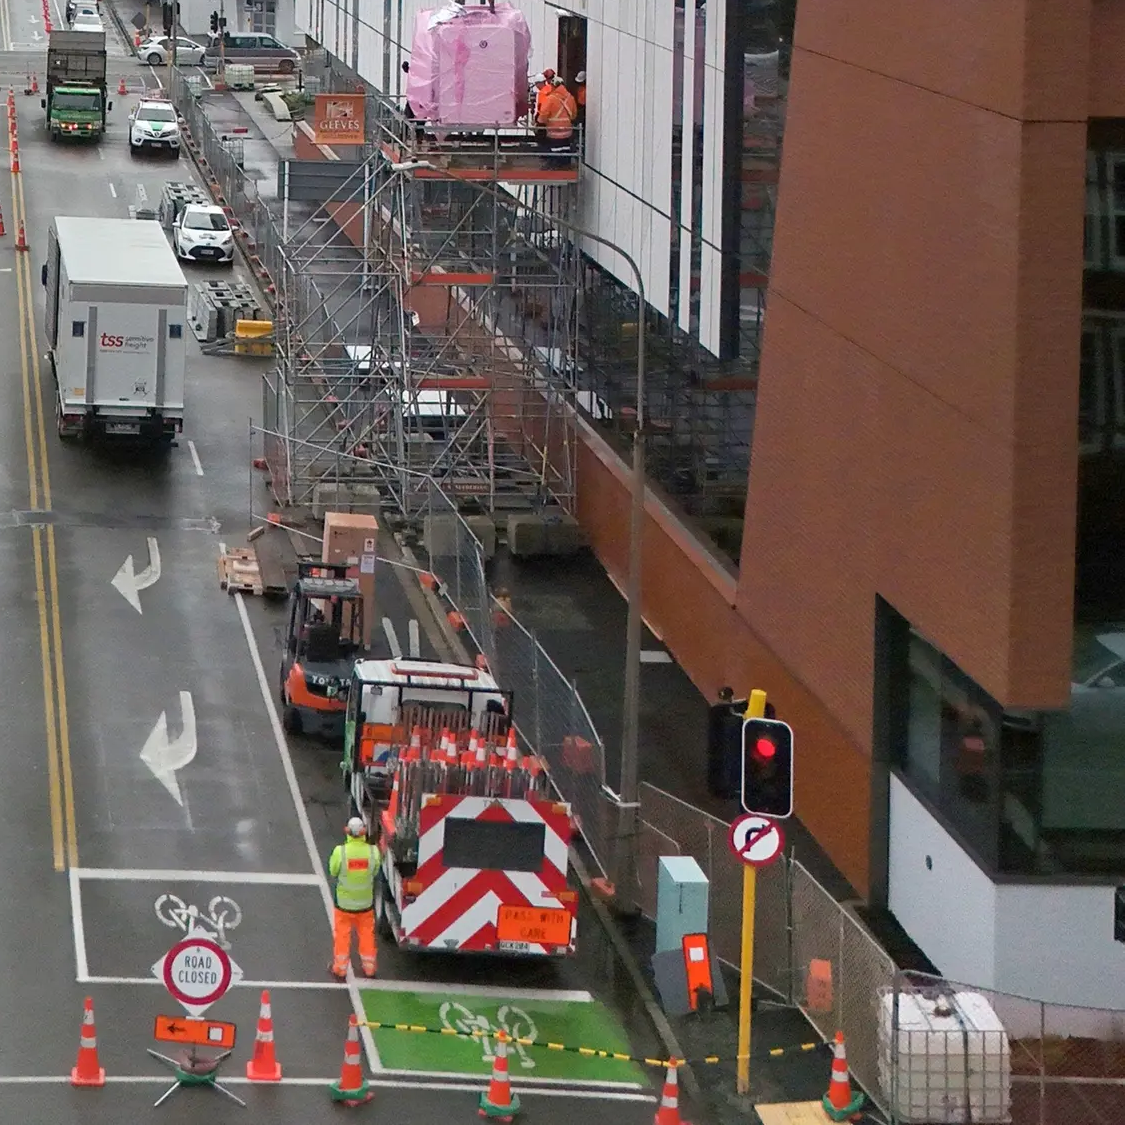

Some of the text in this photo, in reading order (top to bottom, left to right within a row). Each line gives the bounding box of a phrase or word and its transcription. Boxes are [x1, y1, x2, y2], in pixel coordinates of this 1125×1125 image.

[100, 332, 125, 347] tss
[311, 675, 352, 686] TOTA
[540, 911, 564, 924] WITH
[519, 927, 547, 940] CARE
[184, 955, 212, 969] ROAD
[178, 970, 217, 985] CLOSED
